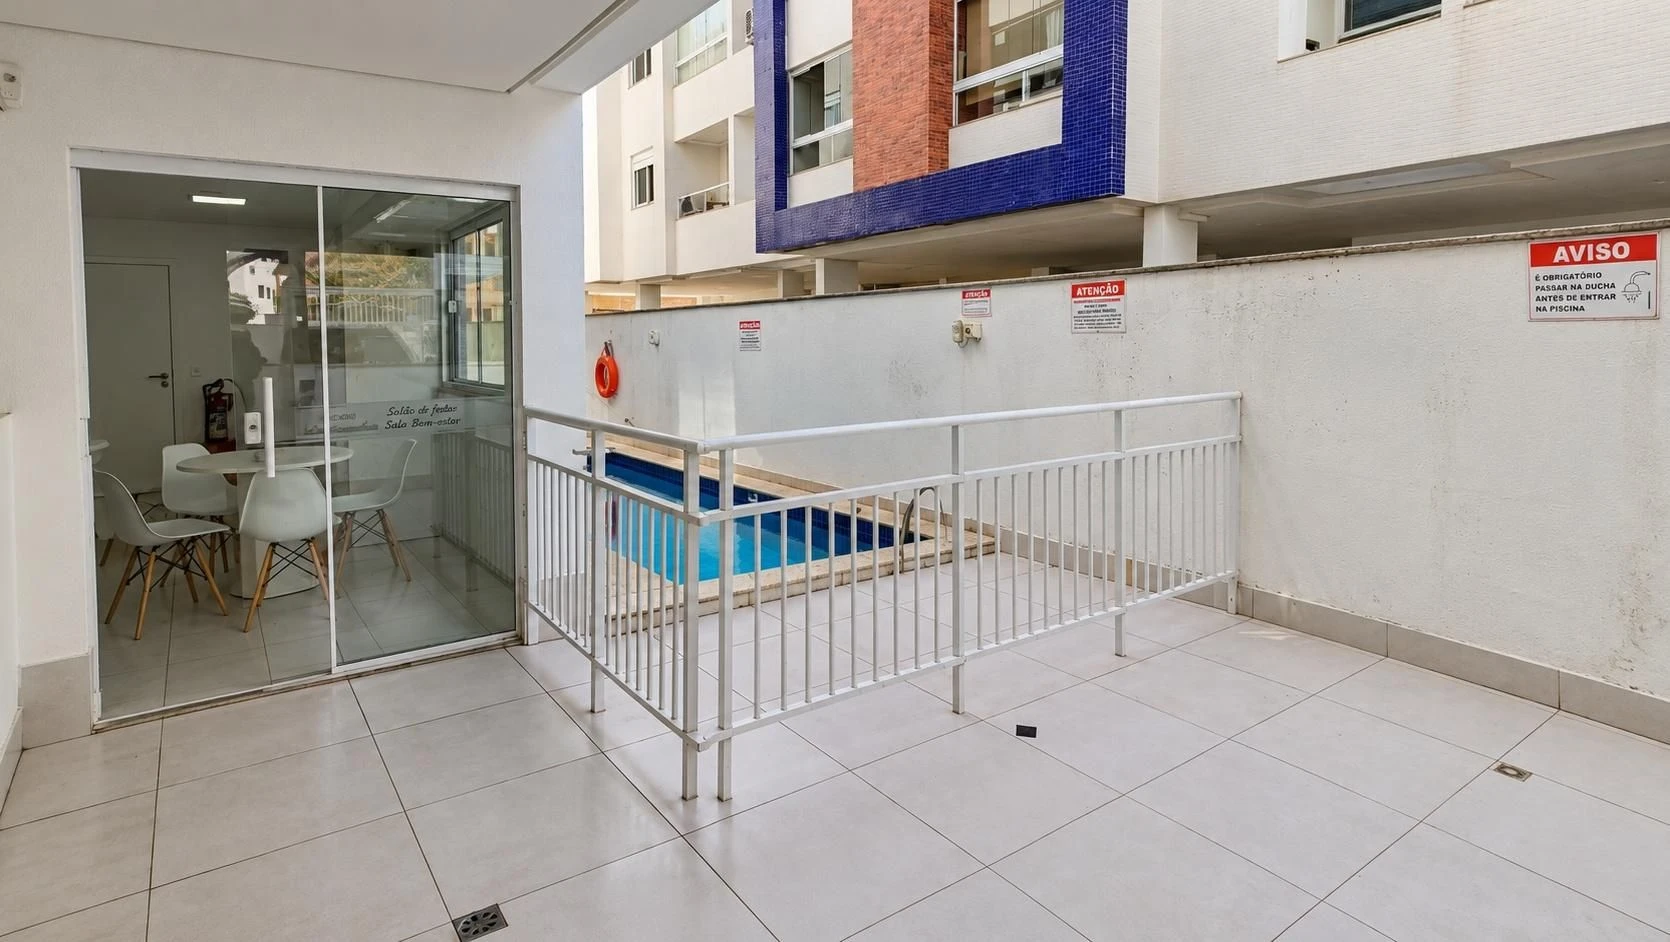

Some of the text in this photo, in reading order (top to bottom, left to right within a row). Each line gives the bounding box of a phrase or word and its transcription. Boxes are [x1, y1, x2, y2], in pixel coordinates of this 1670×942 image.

[1553, 241, 1630, 263] AVISO
[1535, 271, 1602, 281] É OBRIGATÓRIO
[1076, 282, 1119, 296] ATENÇÃO
[1535, 282, 1616, 292] PASSAR NA DUCHA
[1535, 294, 1564, 302] ANTES
[1580, 293, 1616, 301] ENTRAR
[1535, 304, 1585, 313] NA PISCINA
[386, 403, 458, 417] Salão de festas
[384, 419, 407, 430] Sala
[411, 417, 461, 428] Bem-estar
